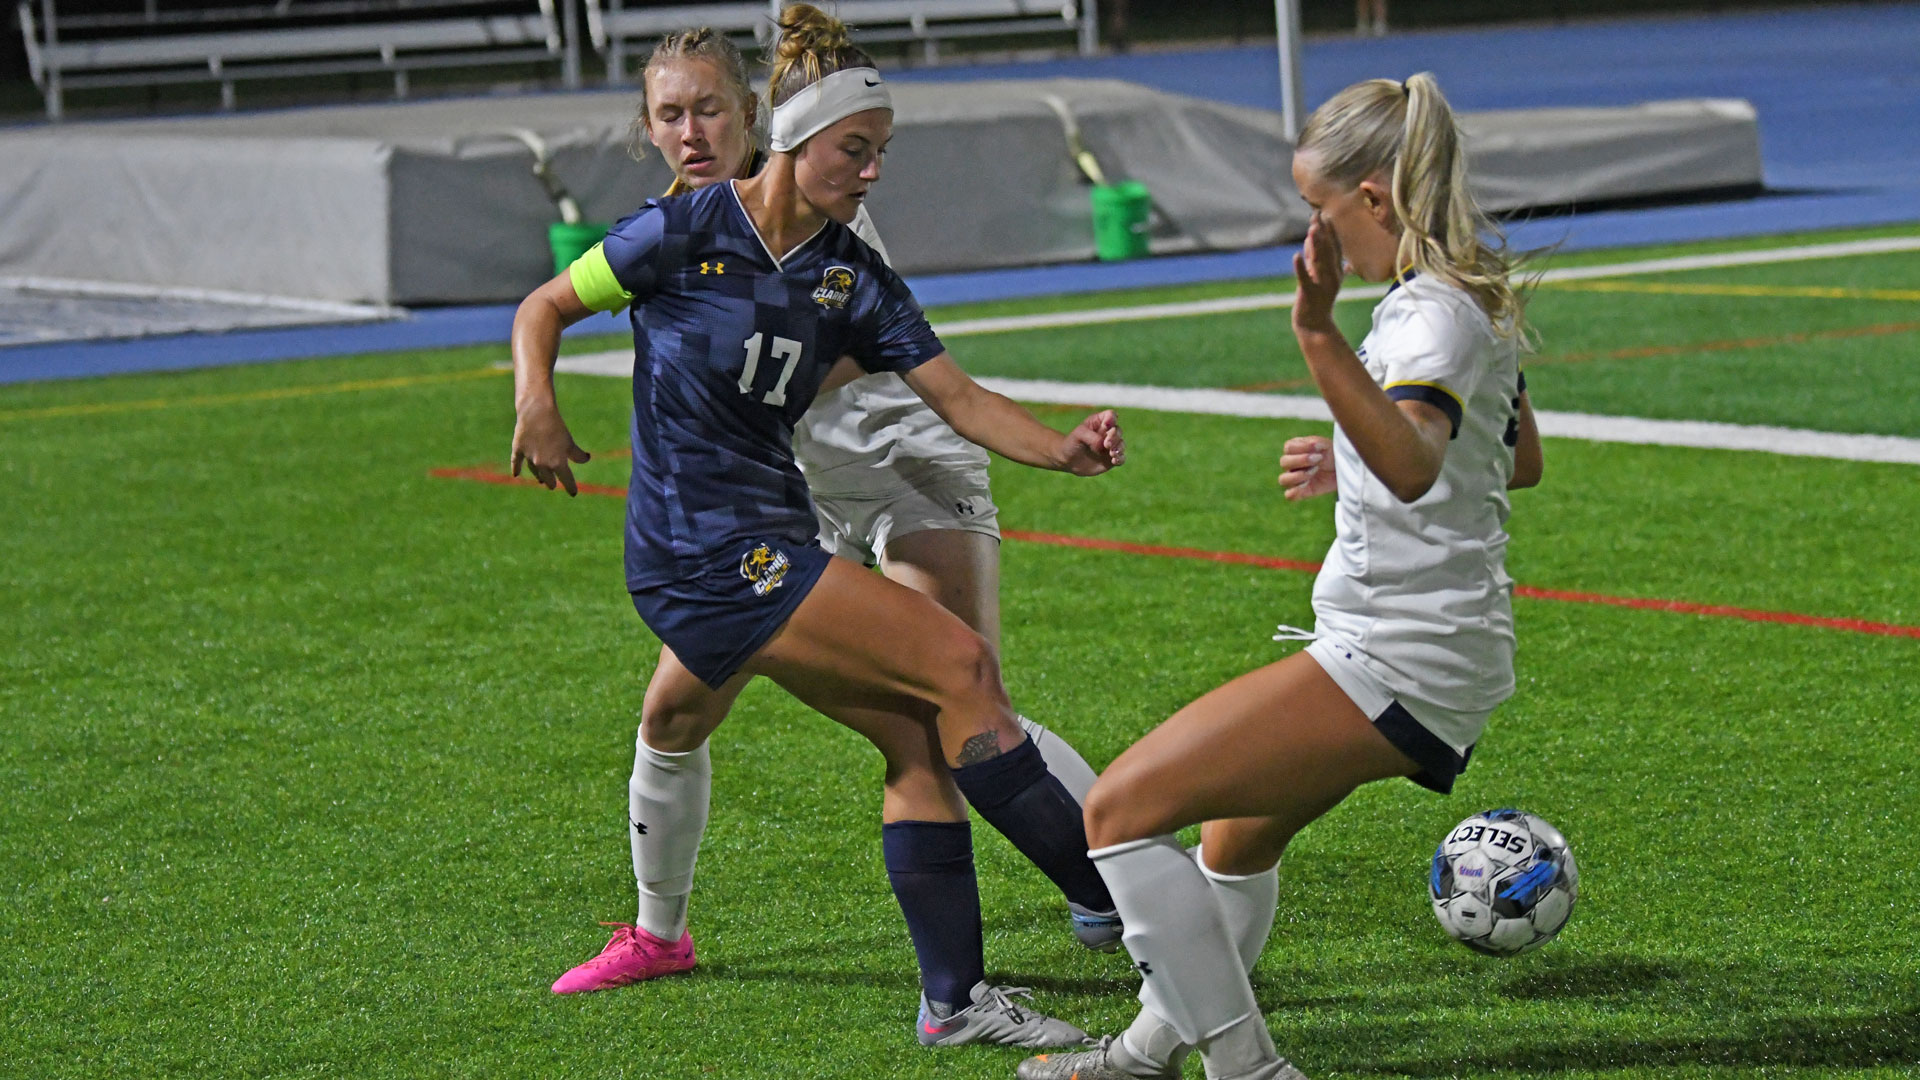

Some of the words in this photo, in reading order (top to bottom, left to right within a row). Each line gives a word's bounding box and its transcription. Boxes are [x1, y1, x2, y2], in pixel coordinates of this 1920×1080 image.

[812, 287, 850, 302] CLARKE
[737, 331, 803, 407] 17
[754, 552, 786, 596] CLARKE
[1448, 825, 1527, 854] SELECT
